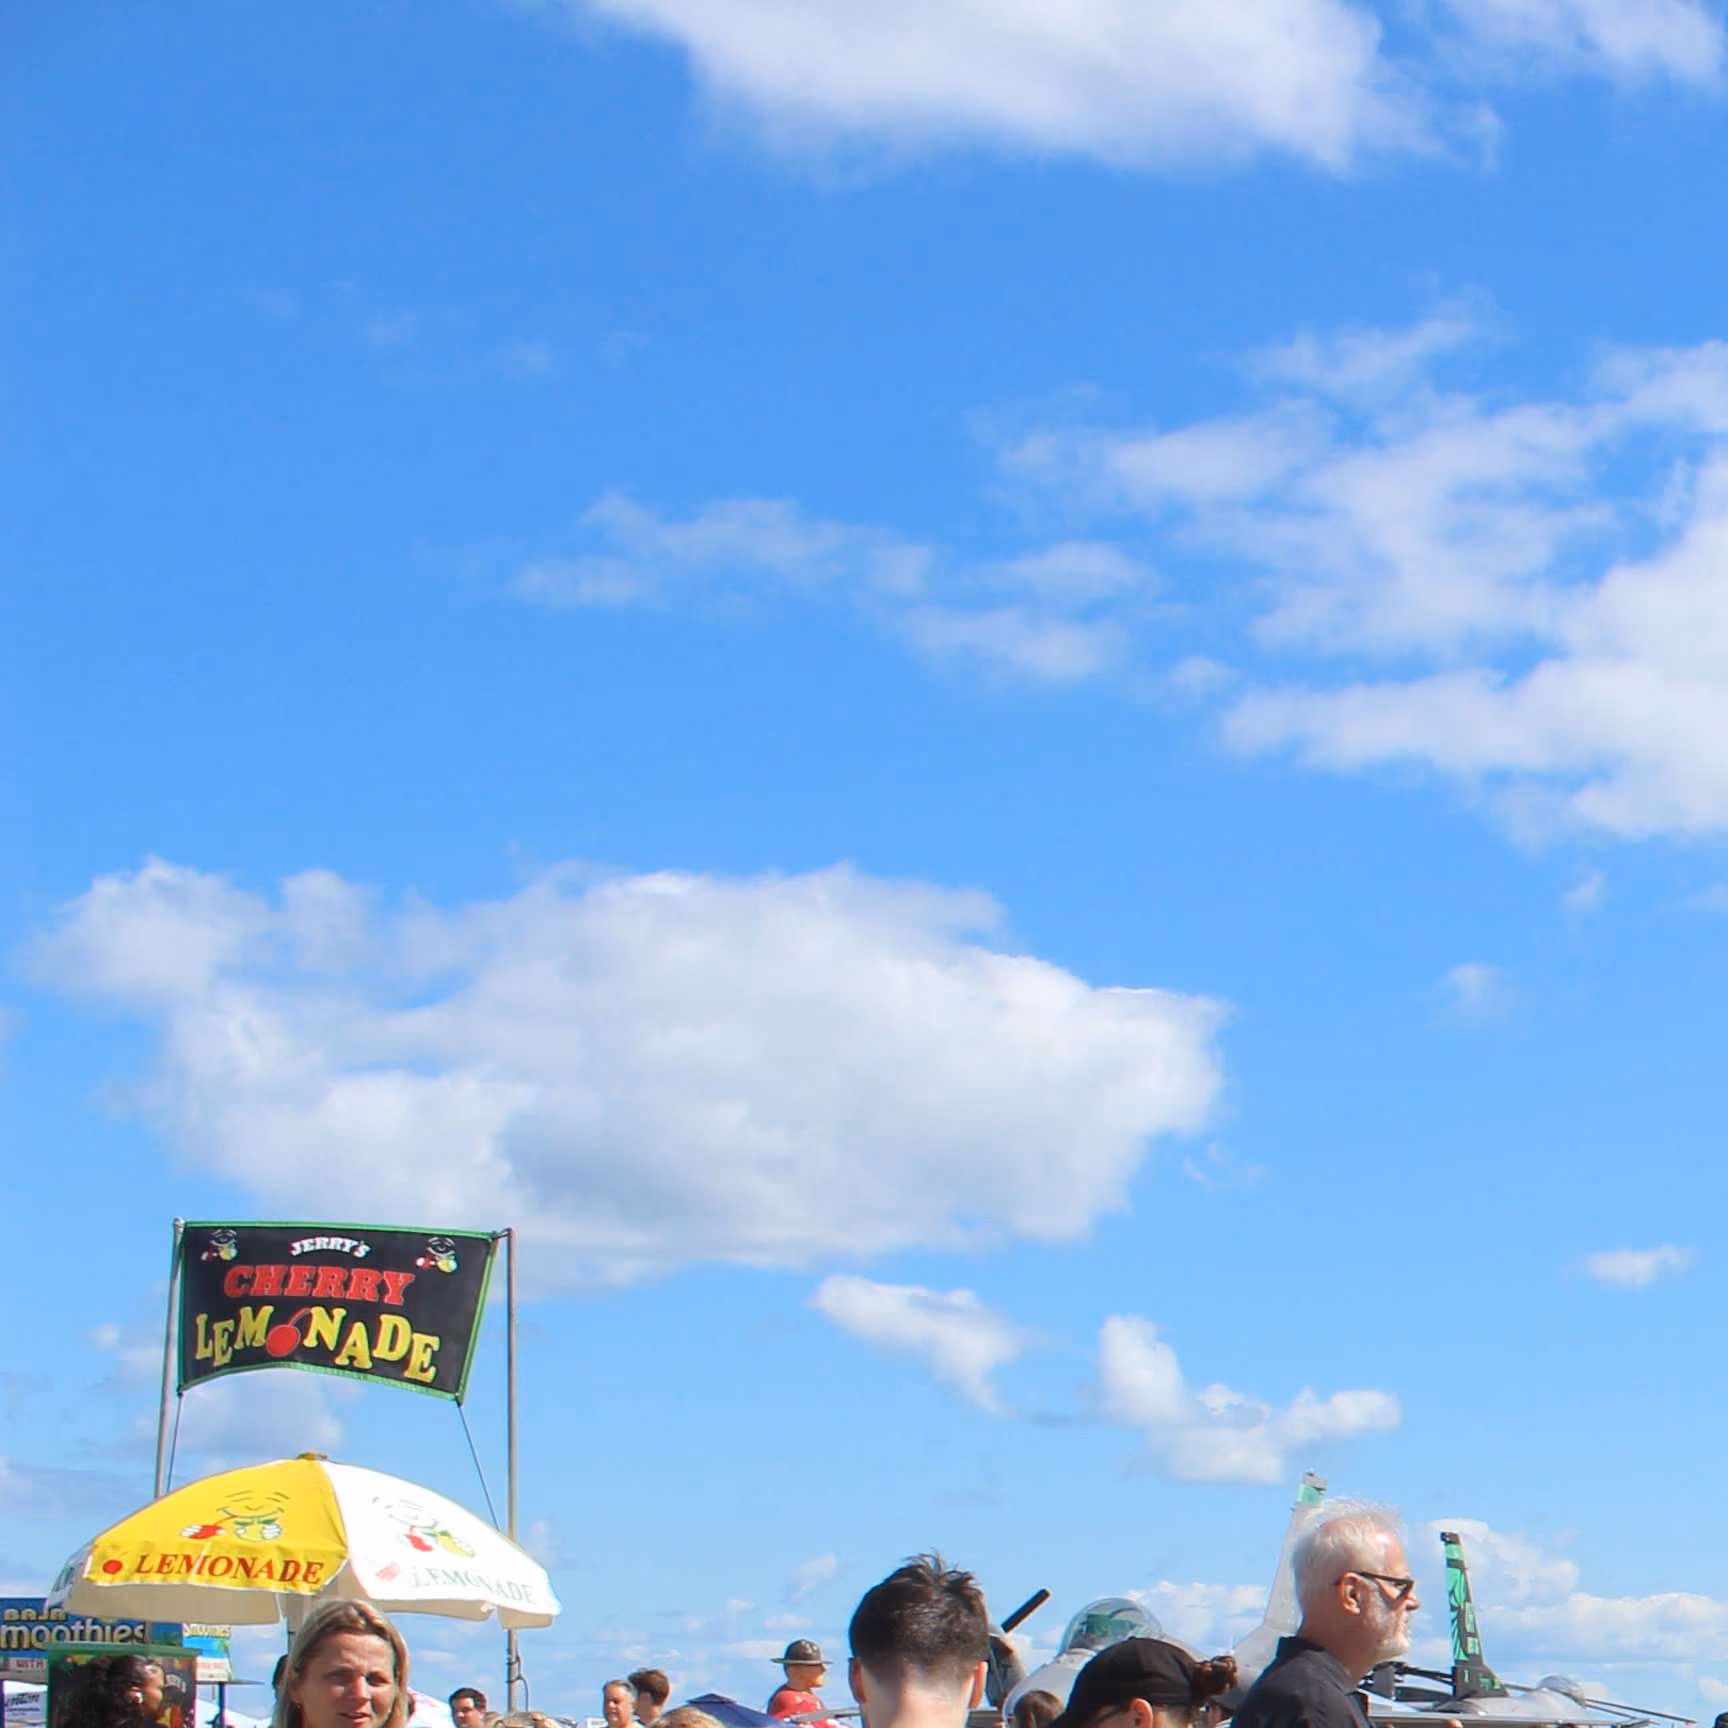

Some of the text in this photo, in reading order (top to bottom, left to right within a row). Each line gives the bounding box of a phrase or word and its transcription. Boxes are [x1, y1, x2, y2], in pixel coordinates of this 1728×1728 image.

[291, 1237, 372, 1258] JERRY'S
[223, 1264, 416, 1305] CHERRY
[135, 1553, 324, 1586] LEMONADE
[409, 1565, 537, 1604] LEMONADE
[0, 1618, 147, 1650] moothies
